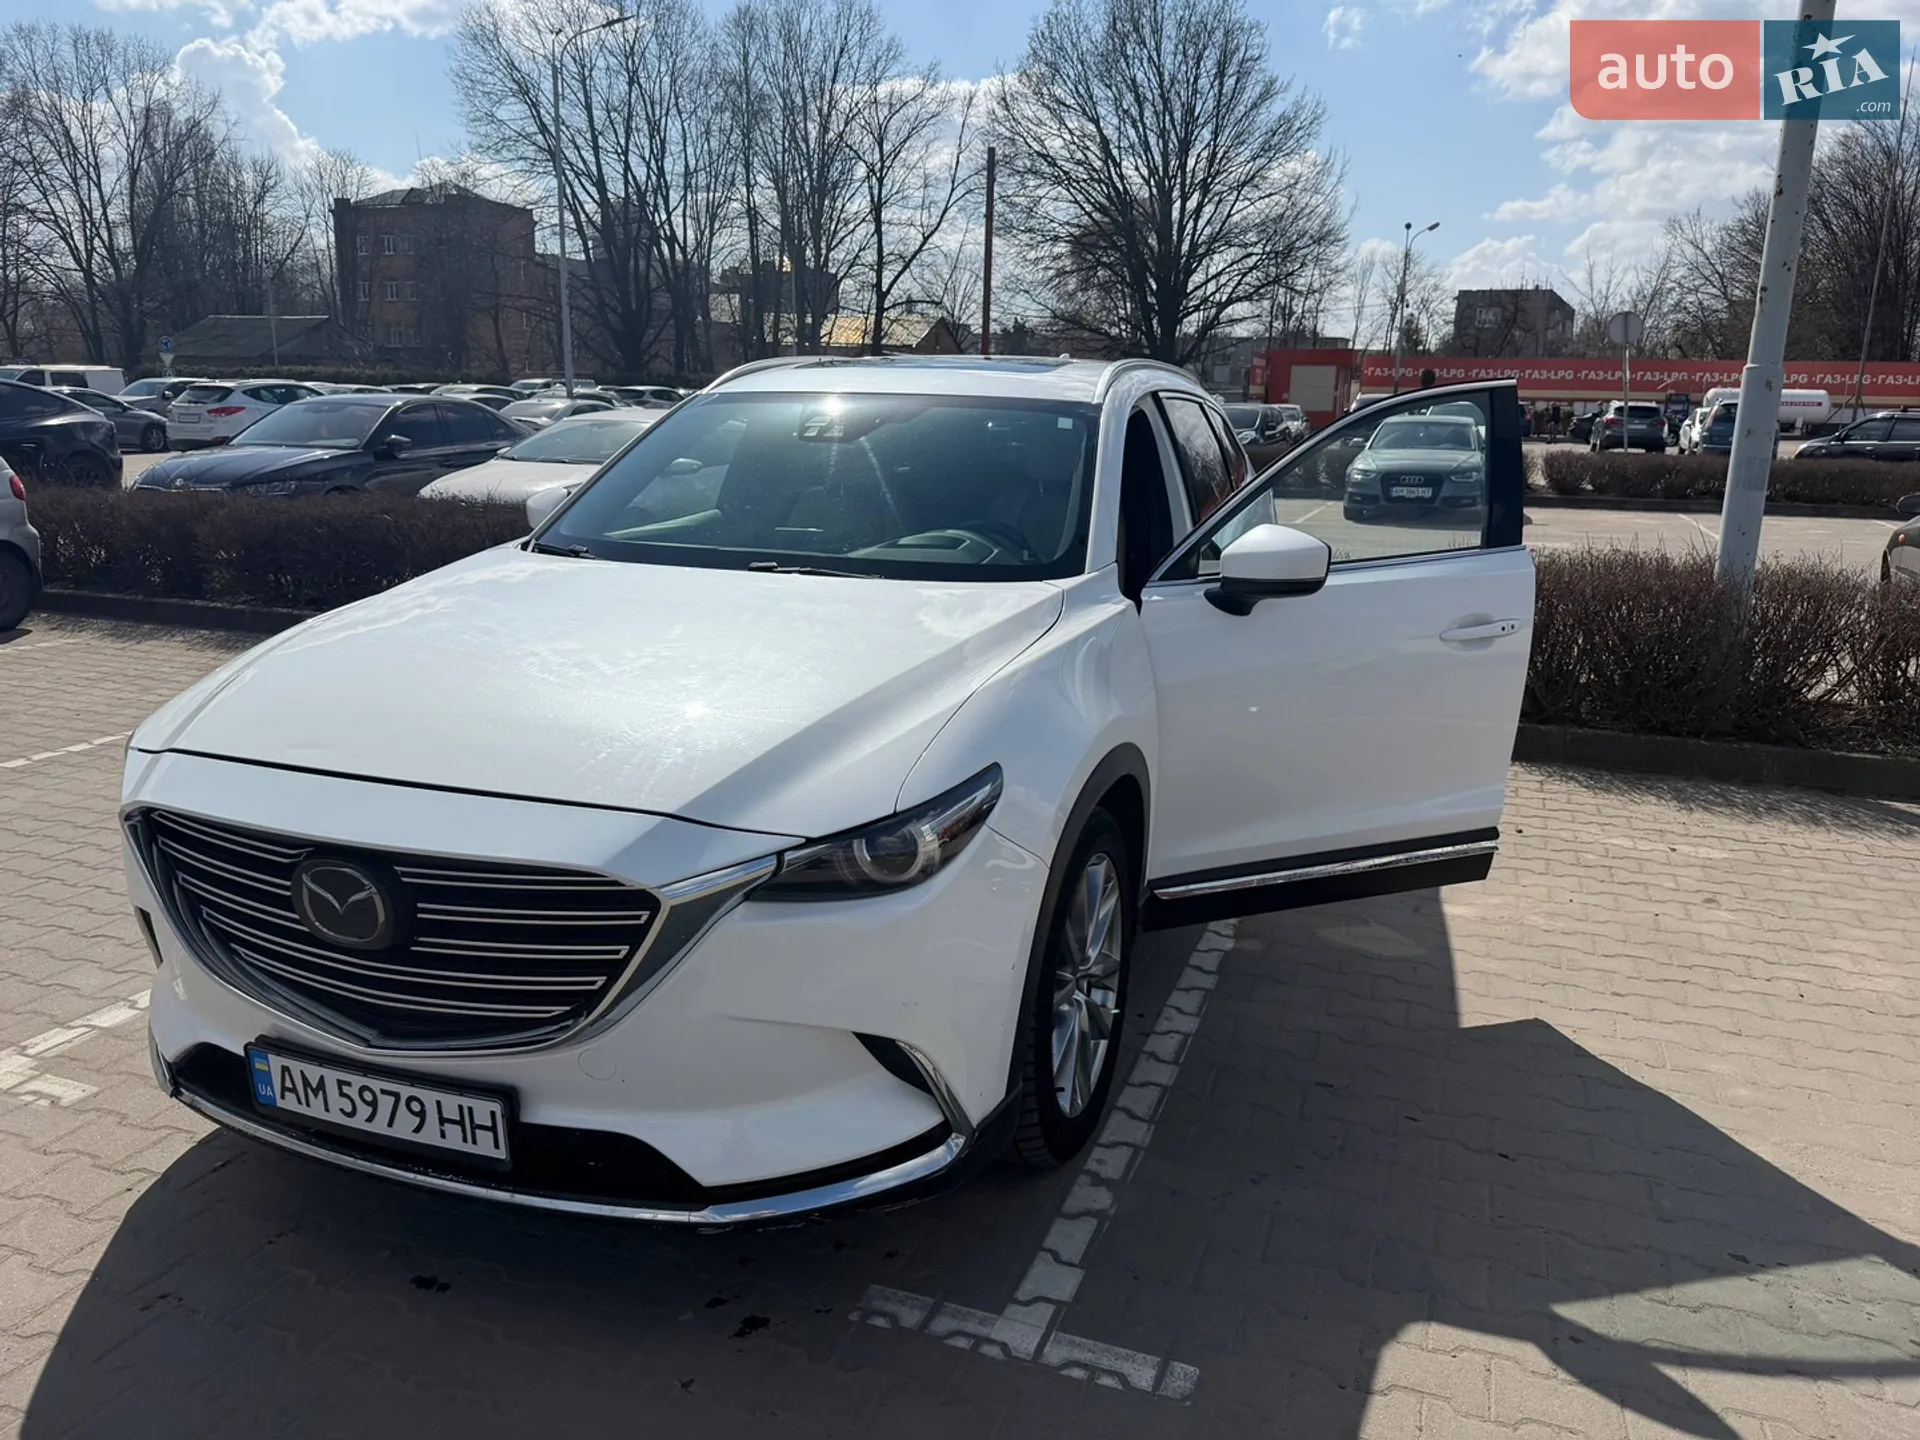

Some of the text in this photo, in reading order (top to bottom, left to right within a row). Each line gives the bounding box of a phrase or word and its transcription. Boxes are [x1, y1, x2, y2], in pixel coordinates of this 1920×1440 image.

[257, 1082, 274, 1099] UA
[280, 1065, 500, 1150] AM 5979 HH
